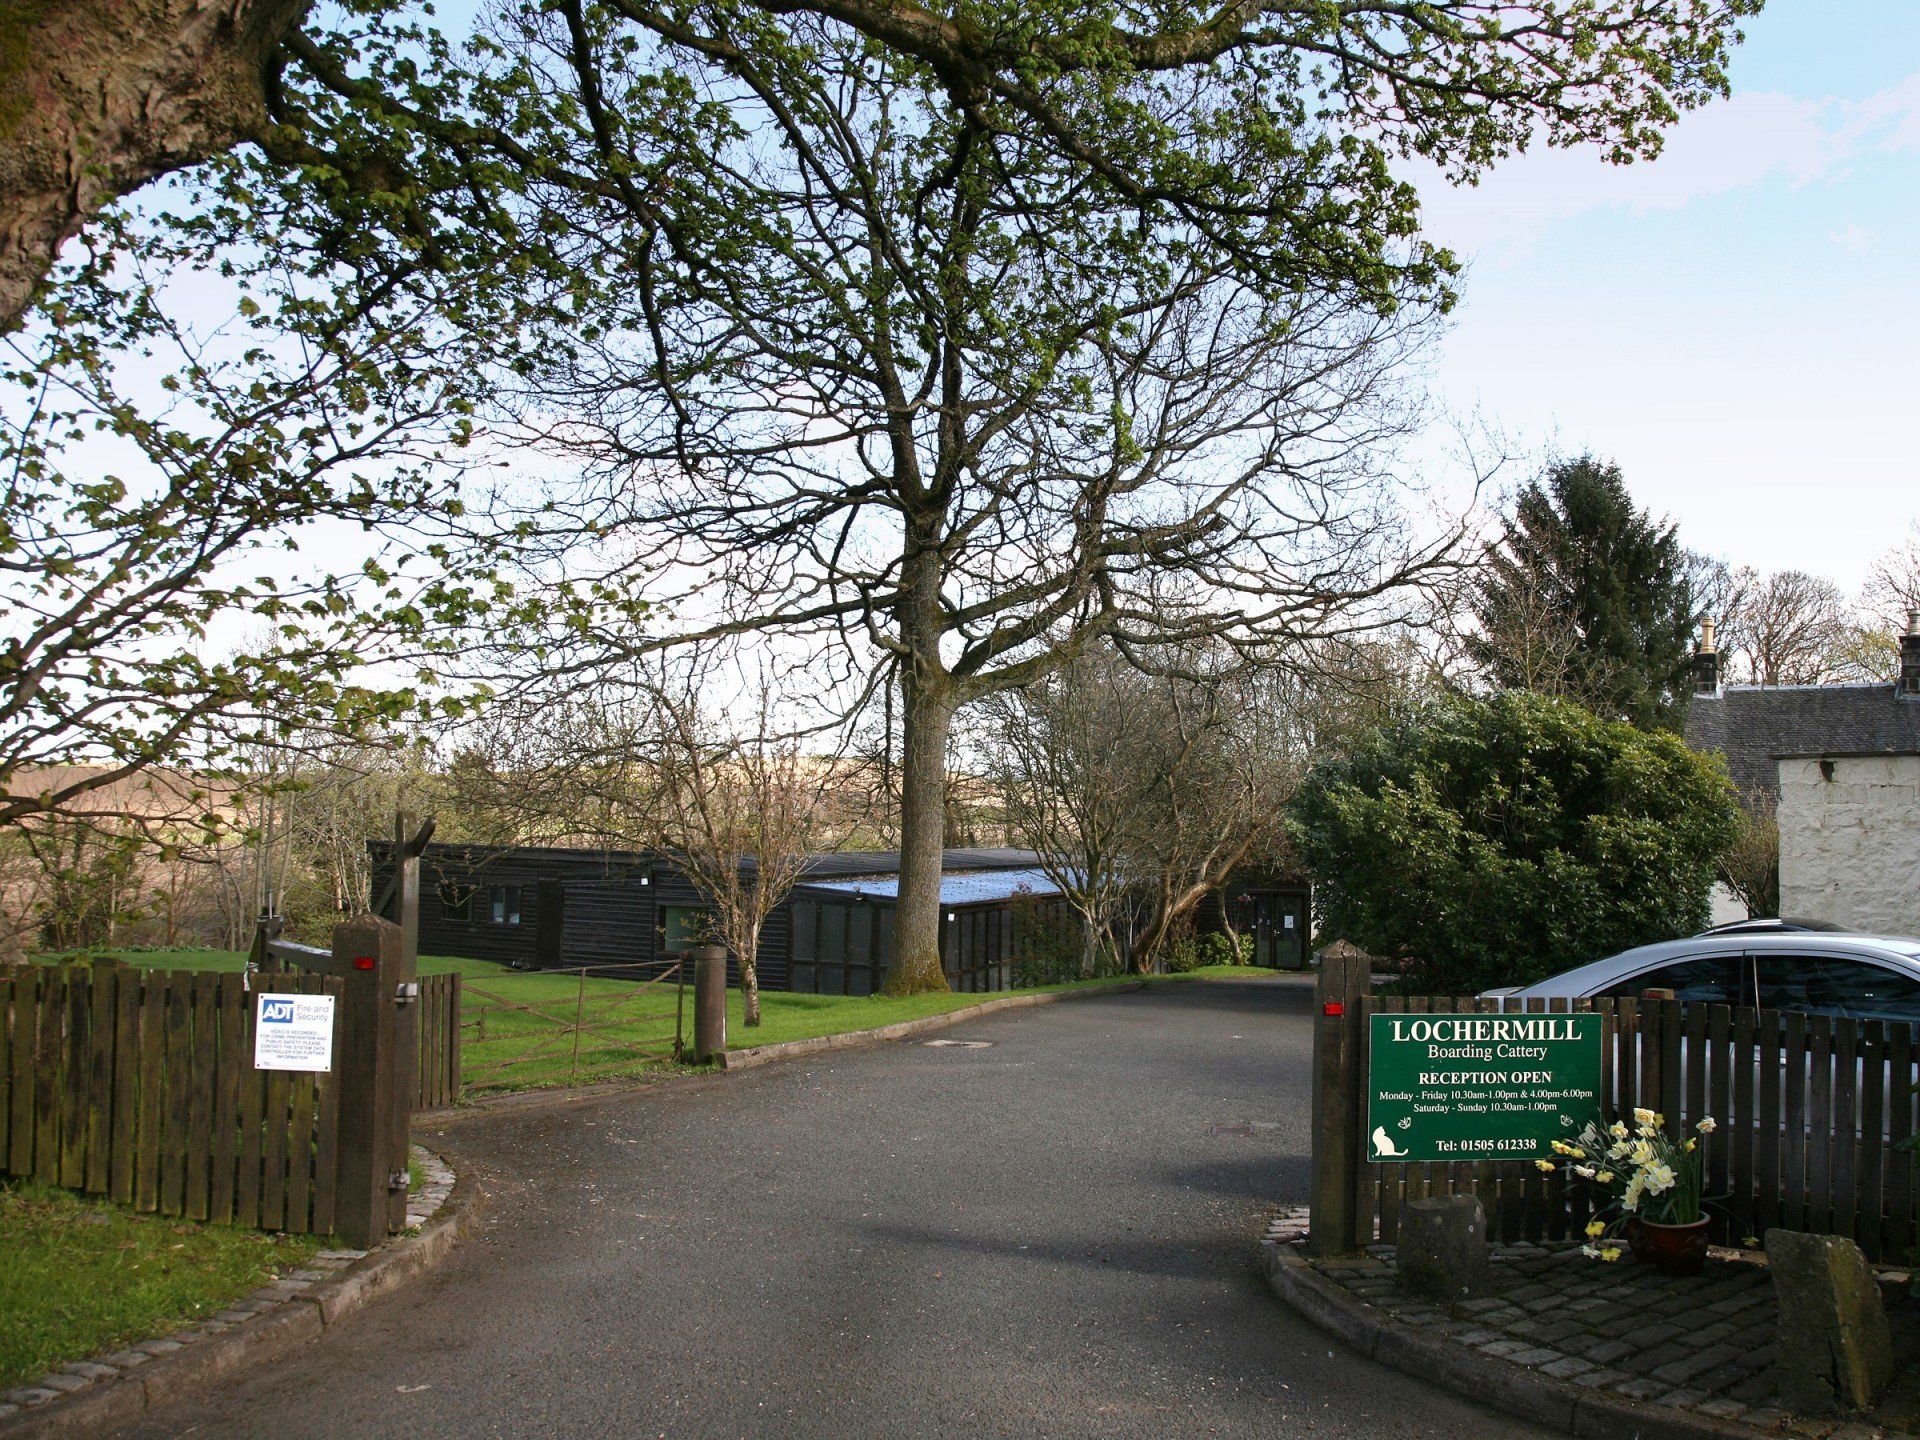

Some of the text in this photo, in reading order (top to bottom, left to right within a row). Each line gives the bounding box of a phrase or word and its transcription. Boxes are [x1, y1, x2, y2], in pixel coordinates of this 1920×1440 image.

[263, 1003, 294, 1019] ADT
[297, 1013, 328, 1022] Security
[1392, 1020, 1582, 1041] LOCHERMILL
[1428, 1044, 1547, 1060] Boarding Cattery
[1419, 1072, 1551, 1084] RECEPTION OPEN
[1380, 1091, 1413, 1101] Monday
[1422, 1091, 1447, 1101] Friday
[1451, 1091, 1518, 1100] 10.30am-1.00pm
[1530, 1090, 1592, 1099] 4.00pm-6.00pm
[1414, 1104, 1449, 1113] Saturday
[1458, 1103, 1487, 1113] Sunday
[1490, 1103, 1557, 1112] 10.30am-1.00pm
[1436, 1139, 1536, 1151] Tel: 01505 612338
